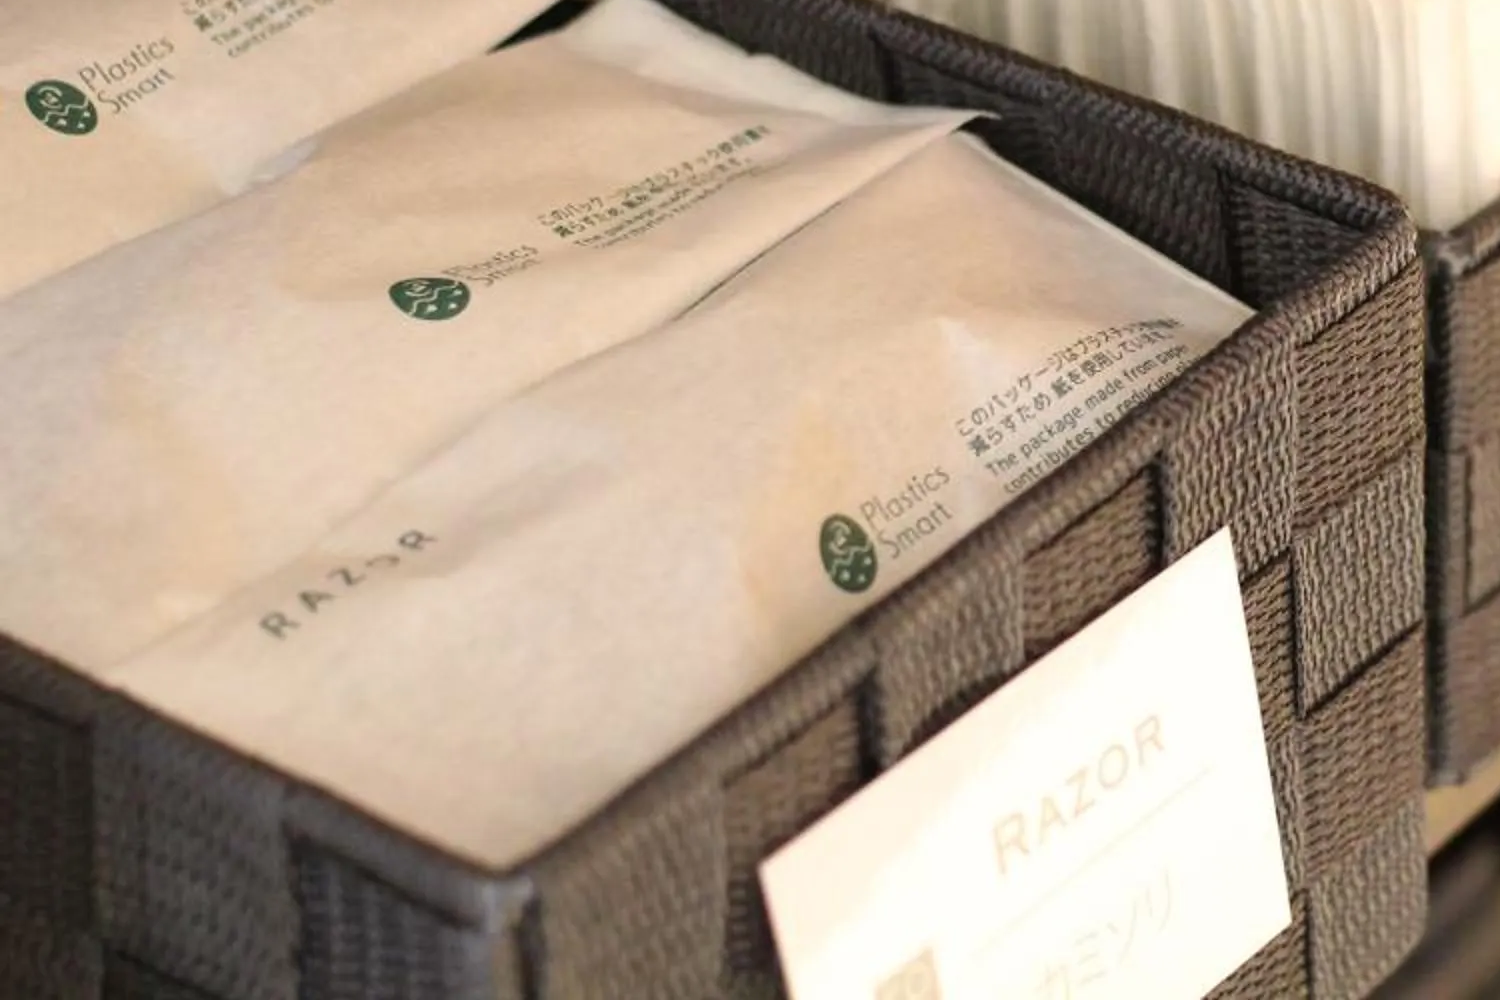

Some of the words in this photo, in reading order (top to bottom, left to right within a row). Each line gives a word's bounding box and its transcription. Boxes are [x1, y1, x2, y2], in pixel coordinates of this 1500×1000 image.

[78, 37, 174, 92] Plastics
[97, 68, 175, 114] Smart
[985, 450, 1019, 476] The
[1020, 405, 1084, 458] package
[1084, 377, 1125, 411] made
[1123, 360, 1158, 383] from
[1003, 426, 1097, 494] contributes
[1095, 412, 1117, 431] to
[860, 466, 950, 532] Plastics
[877, 502, 953, 559] Smart
[992, 714, 1165, 875] RAZOR
